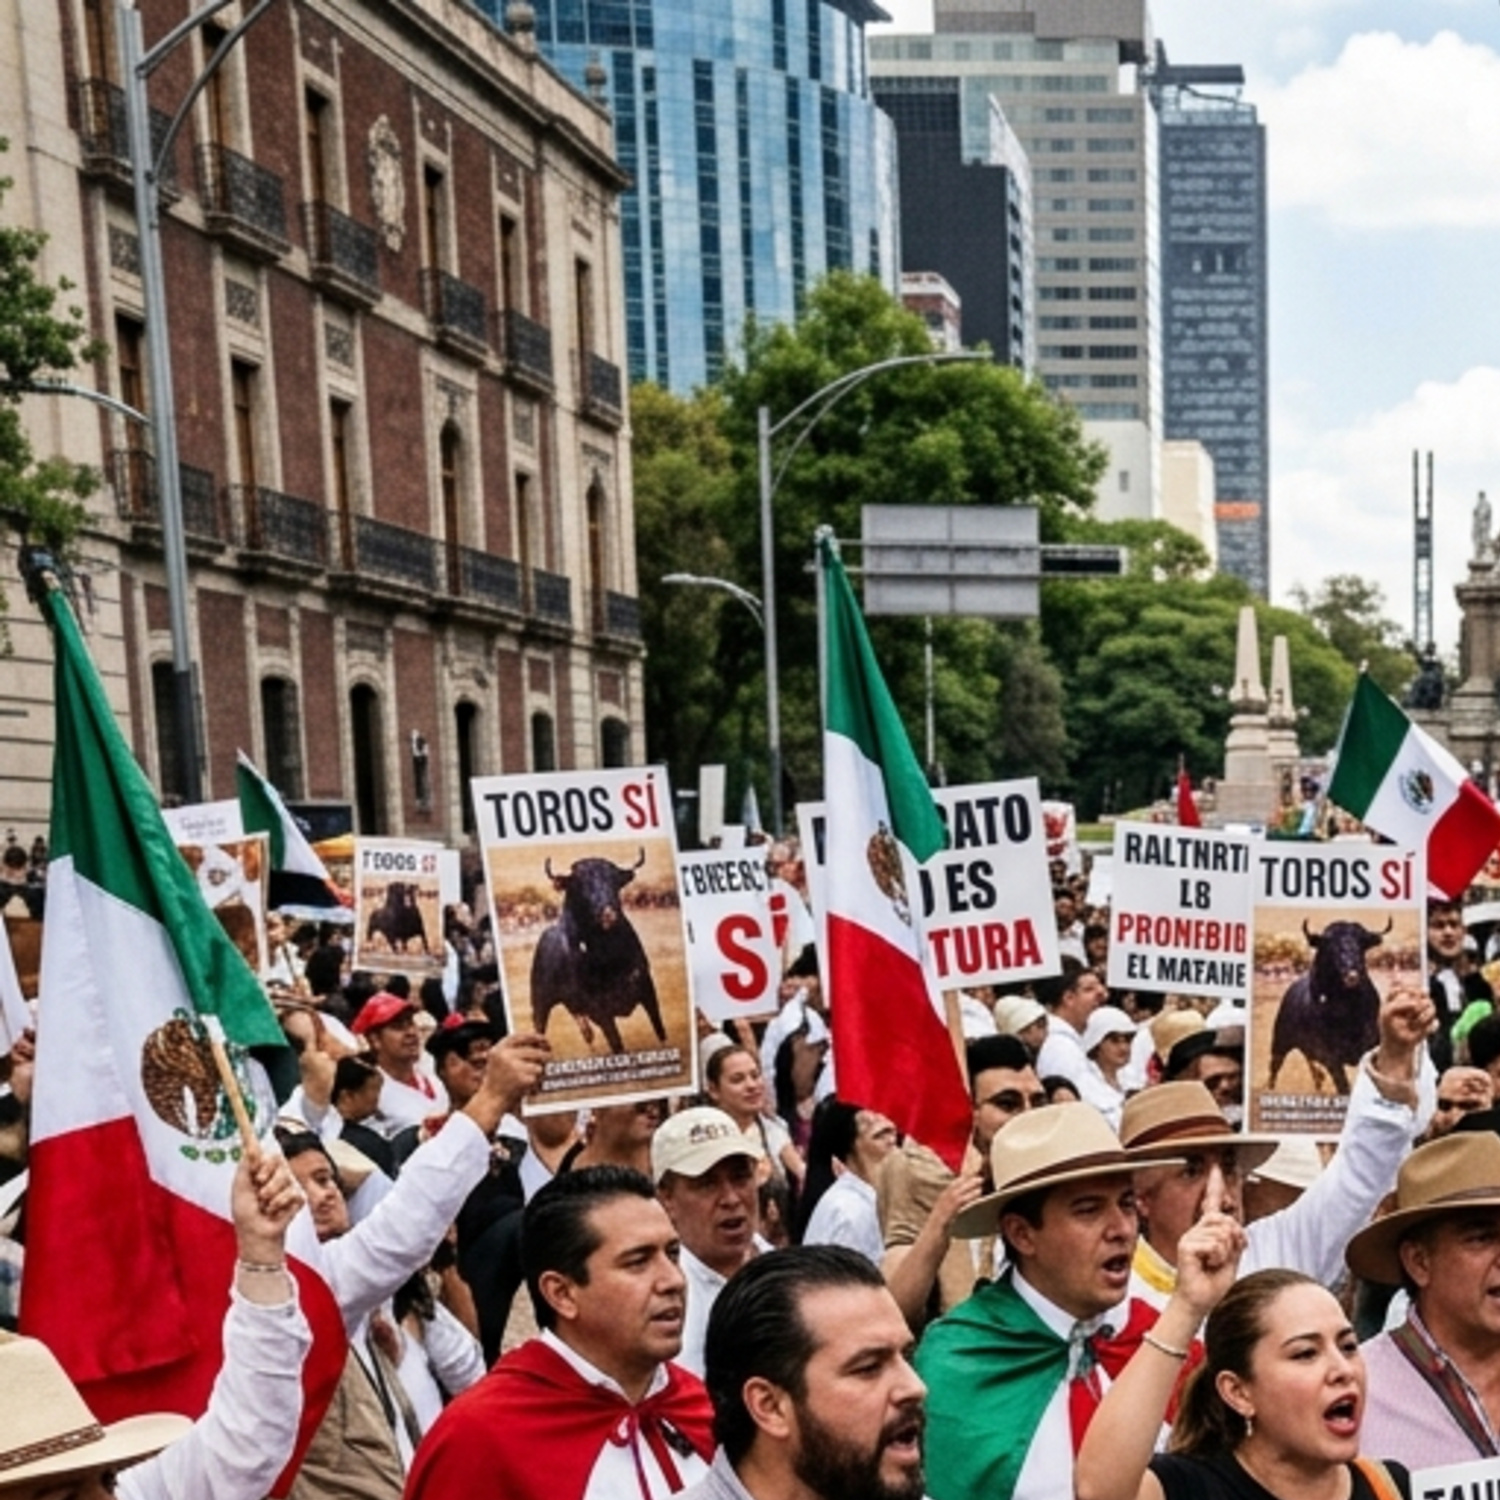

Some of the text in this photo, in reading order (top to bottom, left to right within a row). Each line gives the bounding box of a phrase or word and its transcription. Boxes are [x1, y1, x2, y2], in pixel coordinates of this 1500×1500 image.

[484, 786, 613, 838] TOROS
[945, 860, 997, 913] ES
[1259, 852, 1415, 900] TOROS SÍ
[1126, 952, 1151, 979] EL
